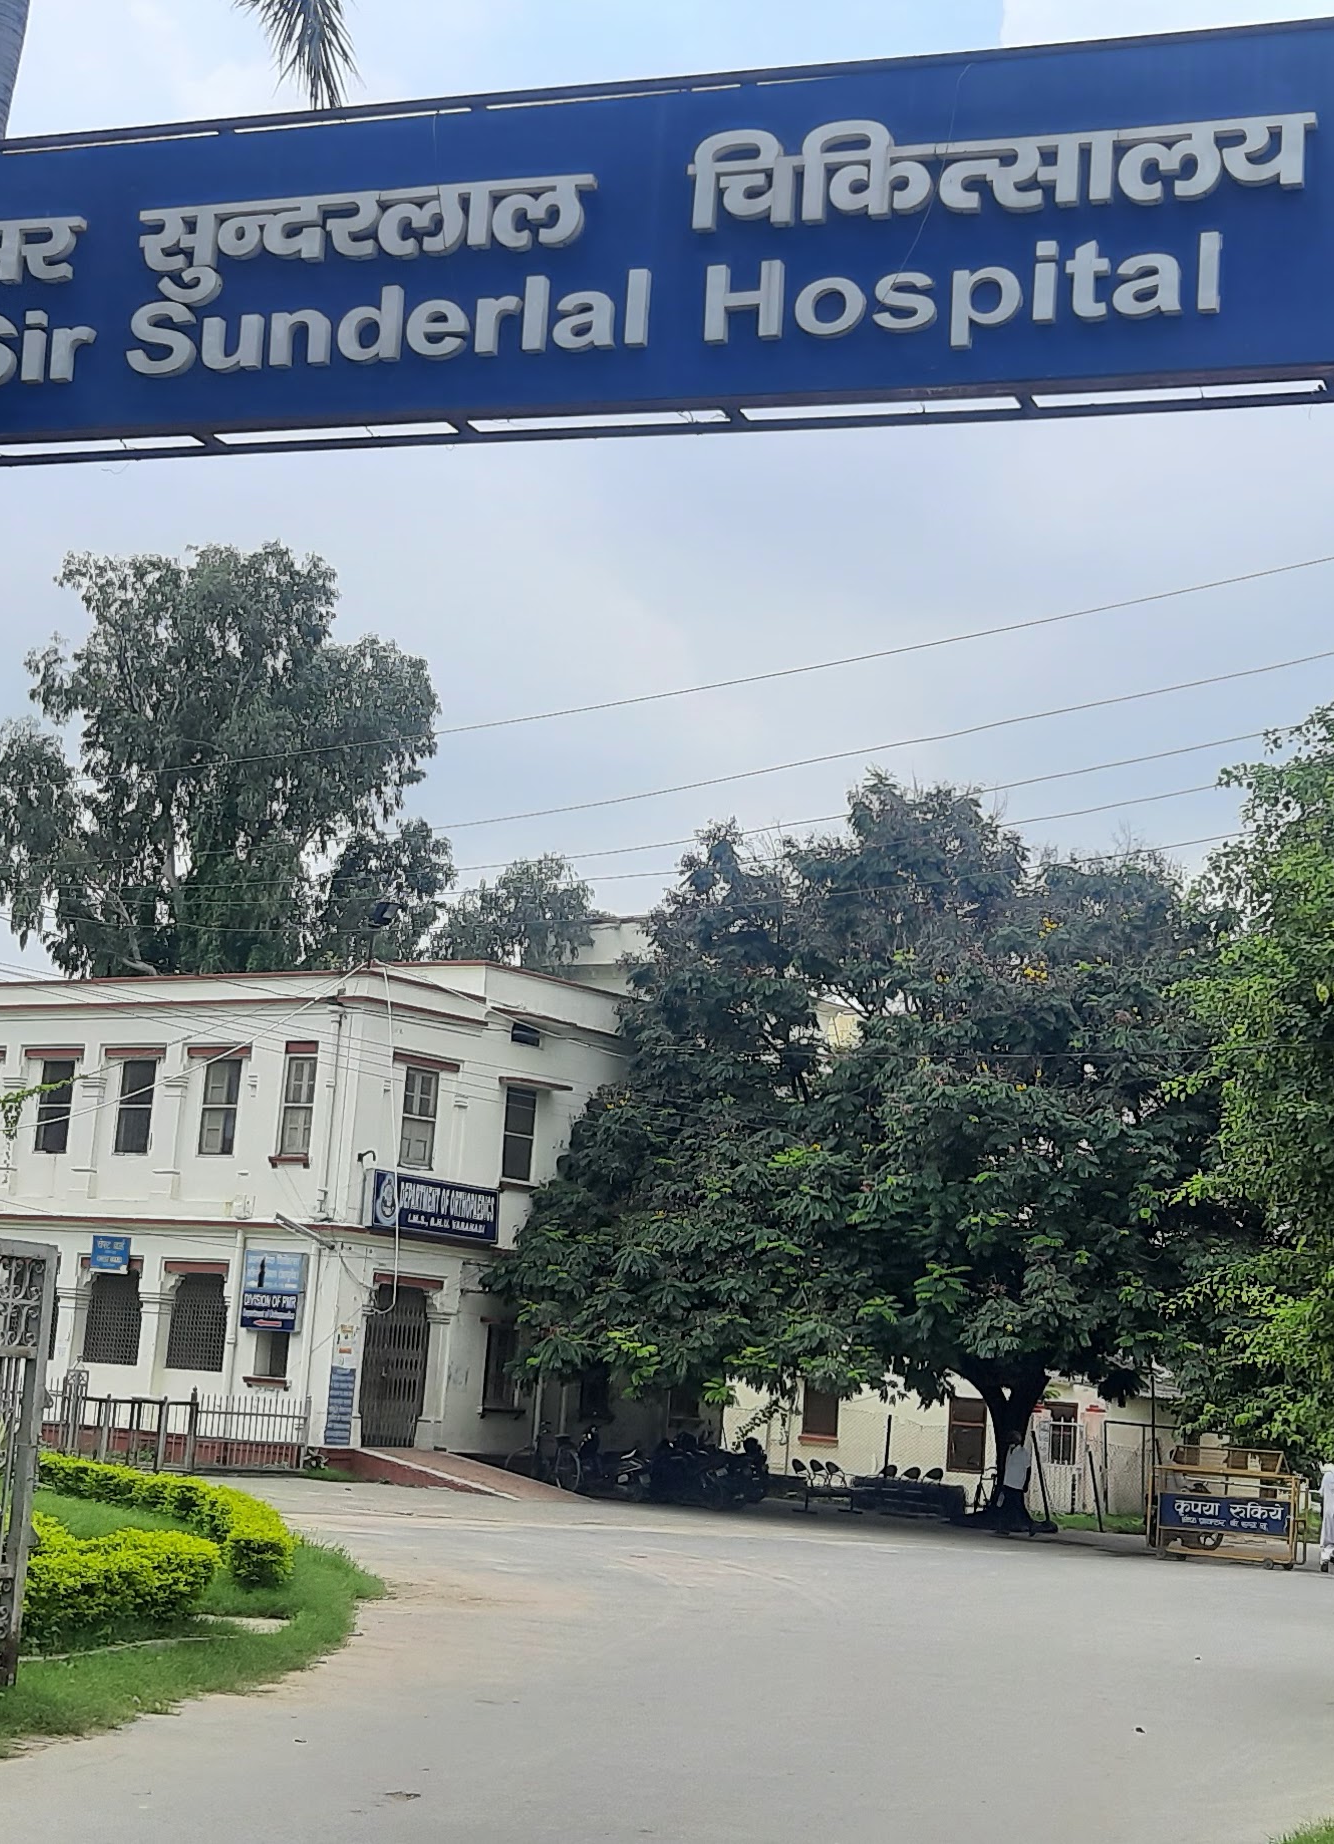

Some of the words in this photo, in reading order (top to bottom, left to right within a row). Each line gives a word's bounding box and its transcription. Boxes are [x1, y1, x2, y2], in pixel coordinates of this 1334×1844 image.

[139, 173, 599, 307] सुन्दरलाल
[686, 111, 1318, 232] चिकित्सालय
[125, 268, 652, 379] Sunderlal
[703, 230, 1223, 350] Hospital
[399, 1181, 441, 1214] DEPARTMENT
[440, 1188, 451, 1216] OF
[244, 1293, 271, 1308] DIVISION
[271, 1294, 282, 1308] OF
[1174, 1499, 1221, 1517] कृपया
[1229, 1502, 1284, 1521] रुकिये
